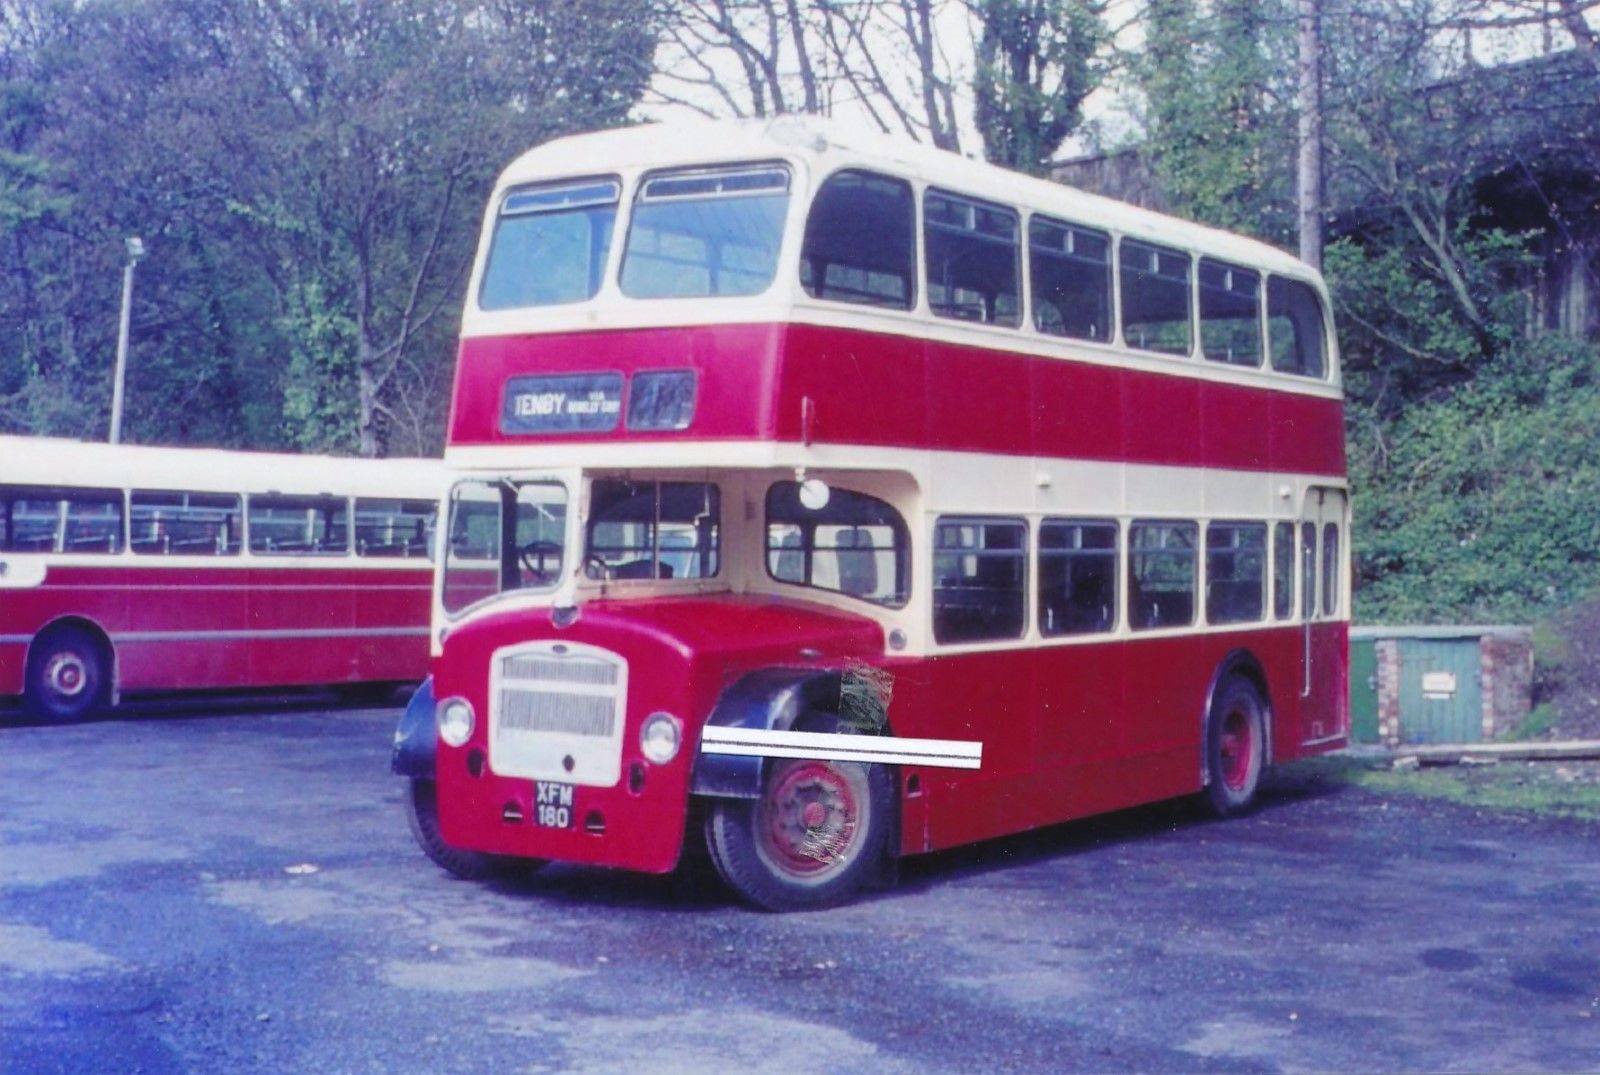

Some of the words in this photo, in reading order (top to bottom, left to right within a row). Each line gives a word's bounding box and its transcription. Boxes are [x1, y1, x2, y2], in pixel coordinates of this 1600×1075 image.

[514, 392, 566, 416] TENBY
[536, 781, 573, 806] XFM
[538, 805, 569, 828] 180
